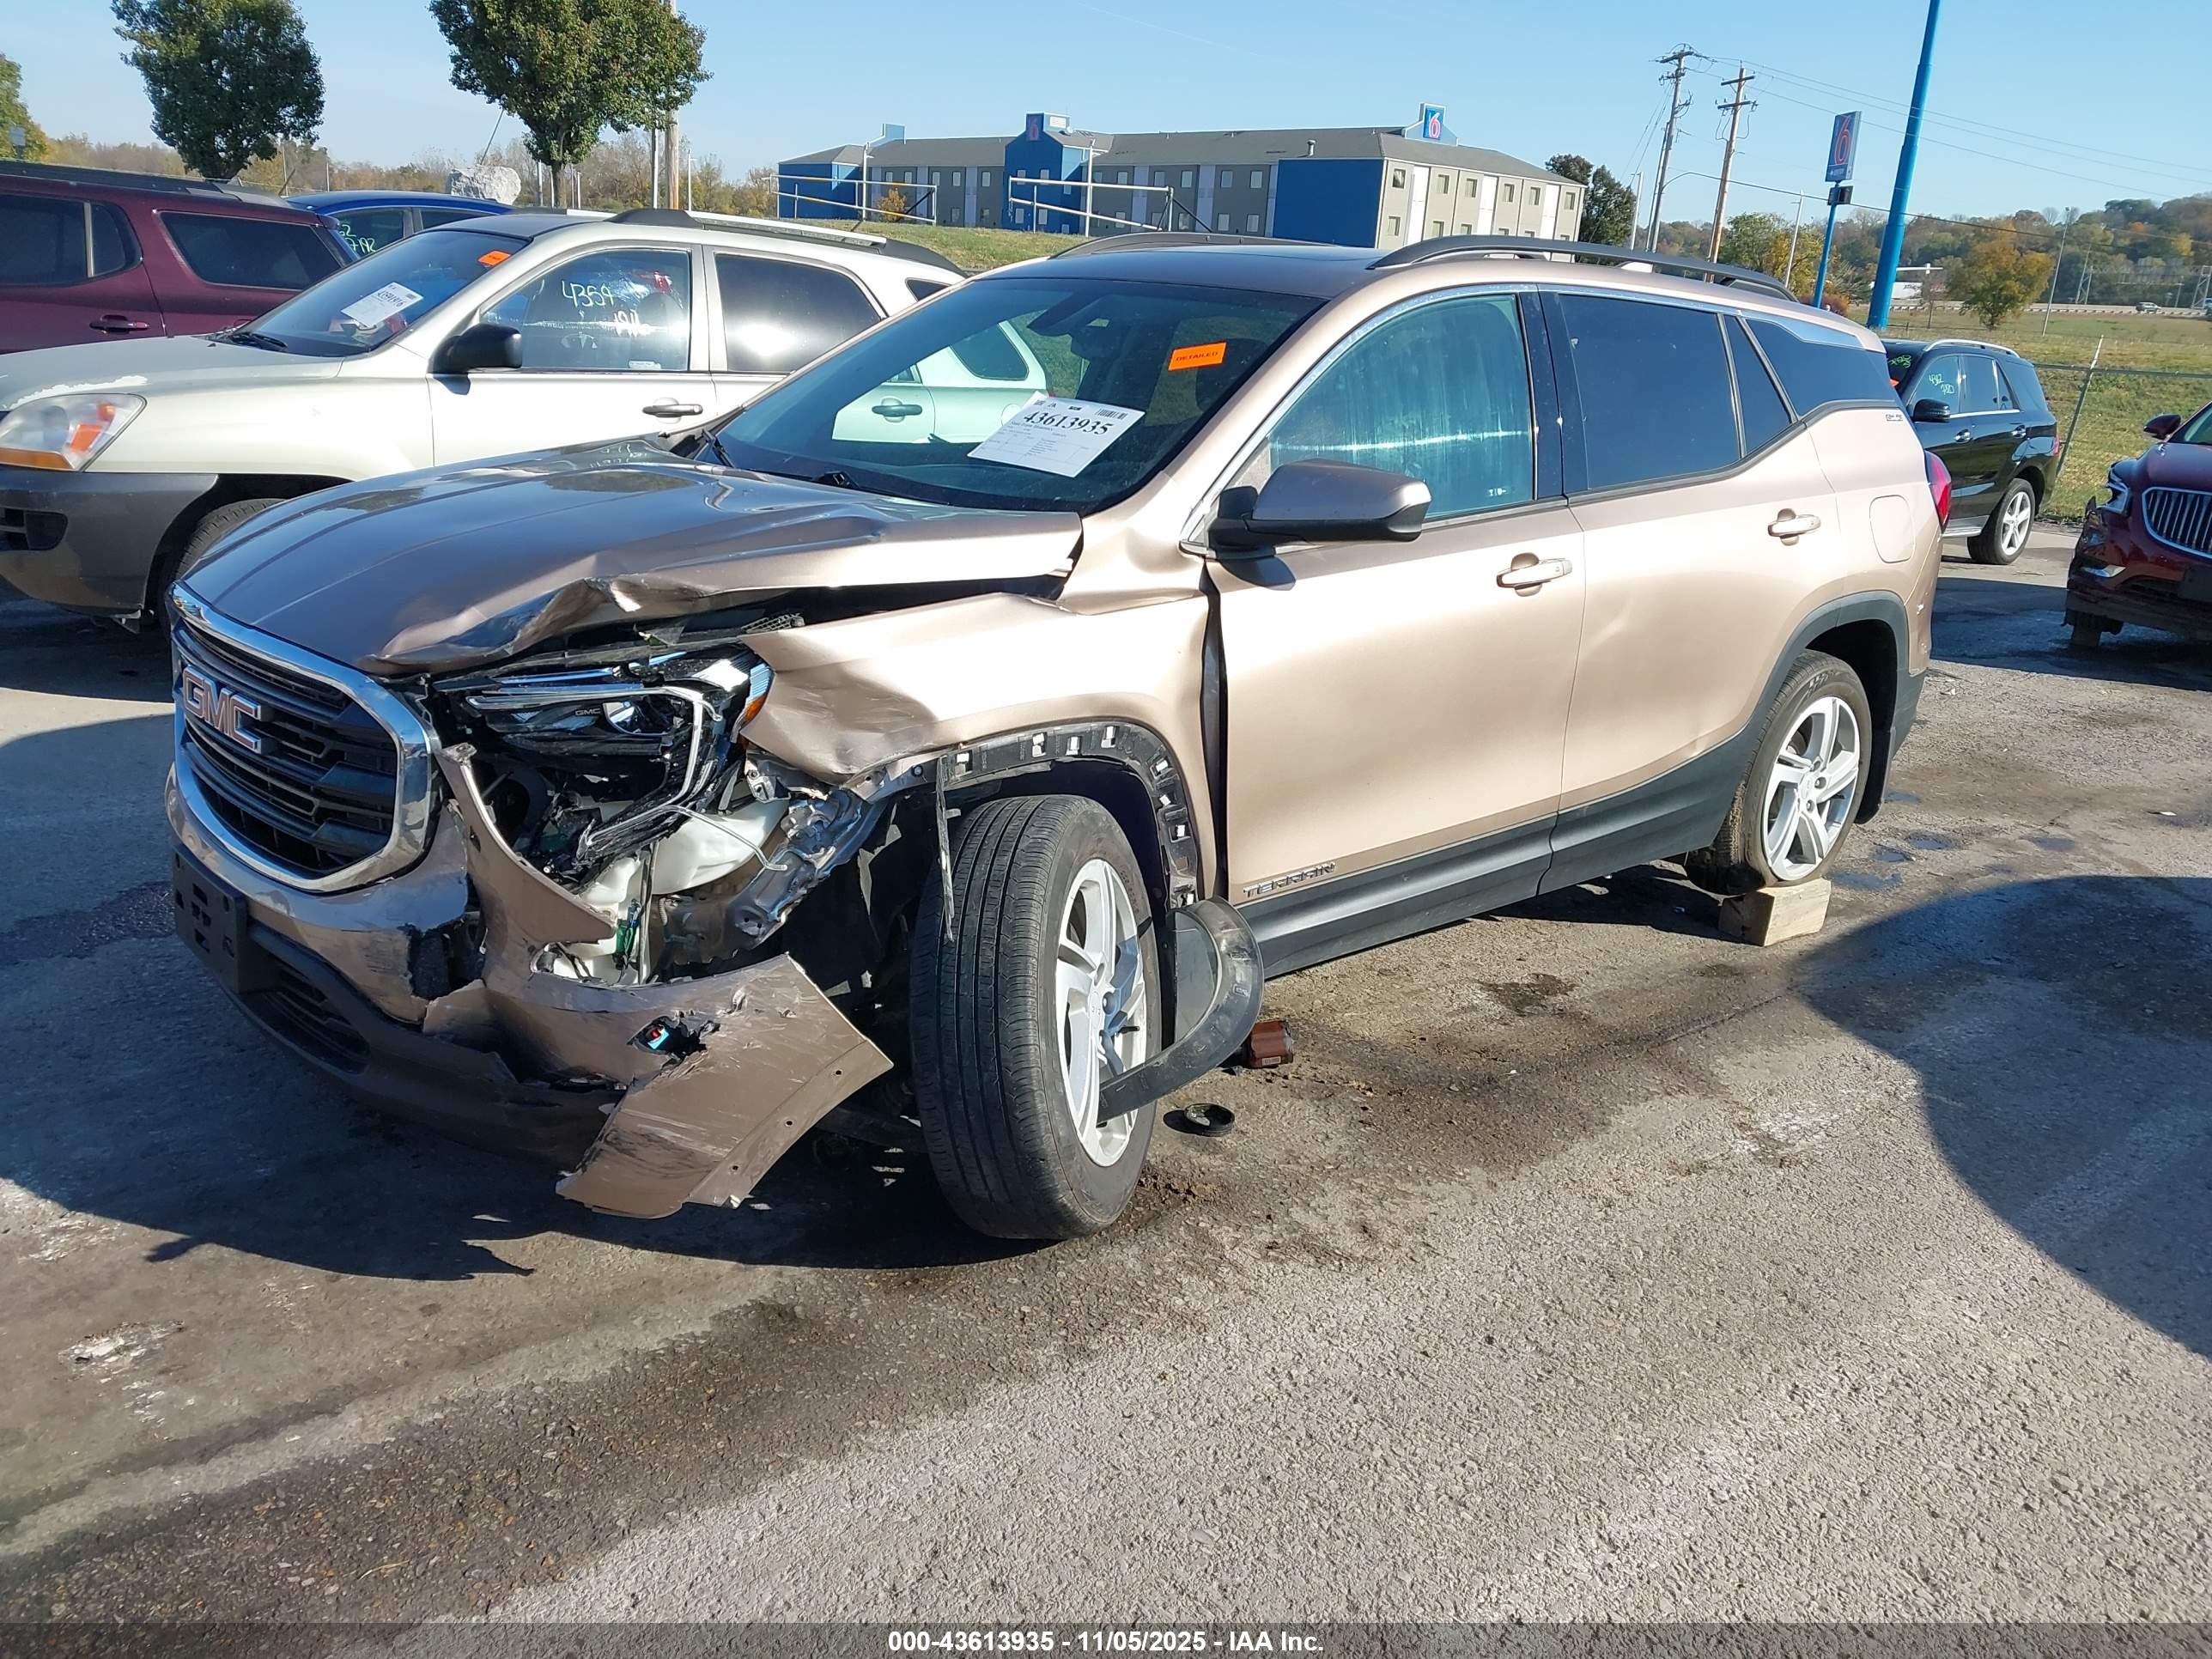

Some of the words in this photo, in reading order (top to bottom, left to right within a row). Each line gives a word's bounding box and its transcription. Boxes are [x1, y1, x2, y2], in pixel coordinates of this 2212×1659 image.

[1429, 112, 1440, 137] 6
[1835, 114, 1851, 165] 6
[562, 280, 614, 307] 4359
[1176, 351, 1218, 362] DETAILED
[1024, 410, 1114, 435] 43613935
[183, 665, 261, 754] GMC
[1243, 861, 1336, 898] TERRAIN
